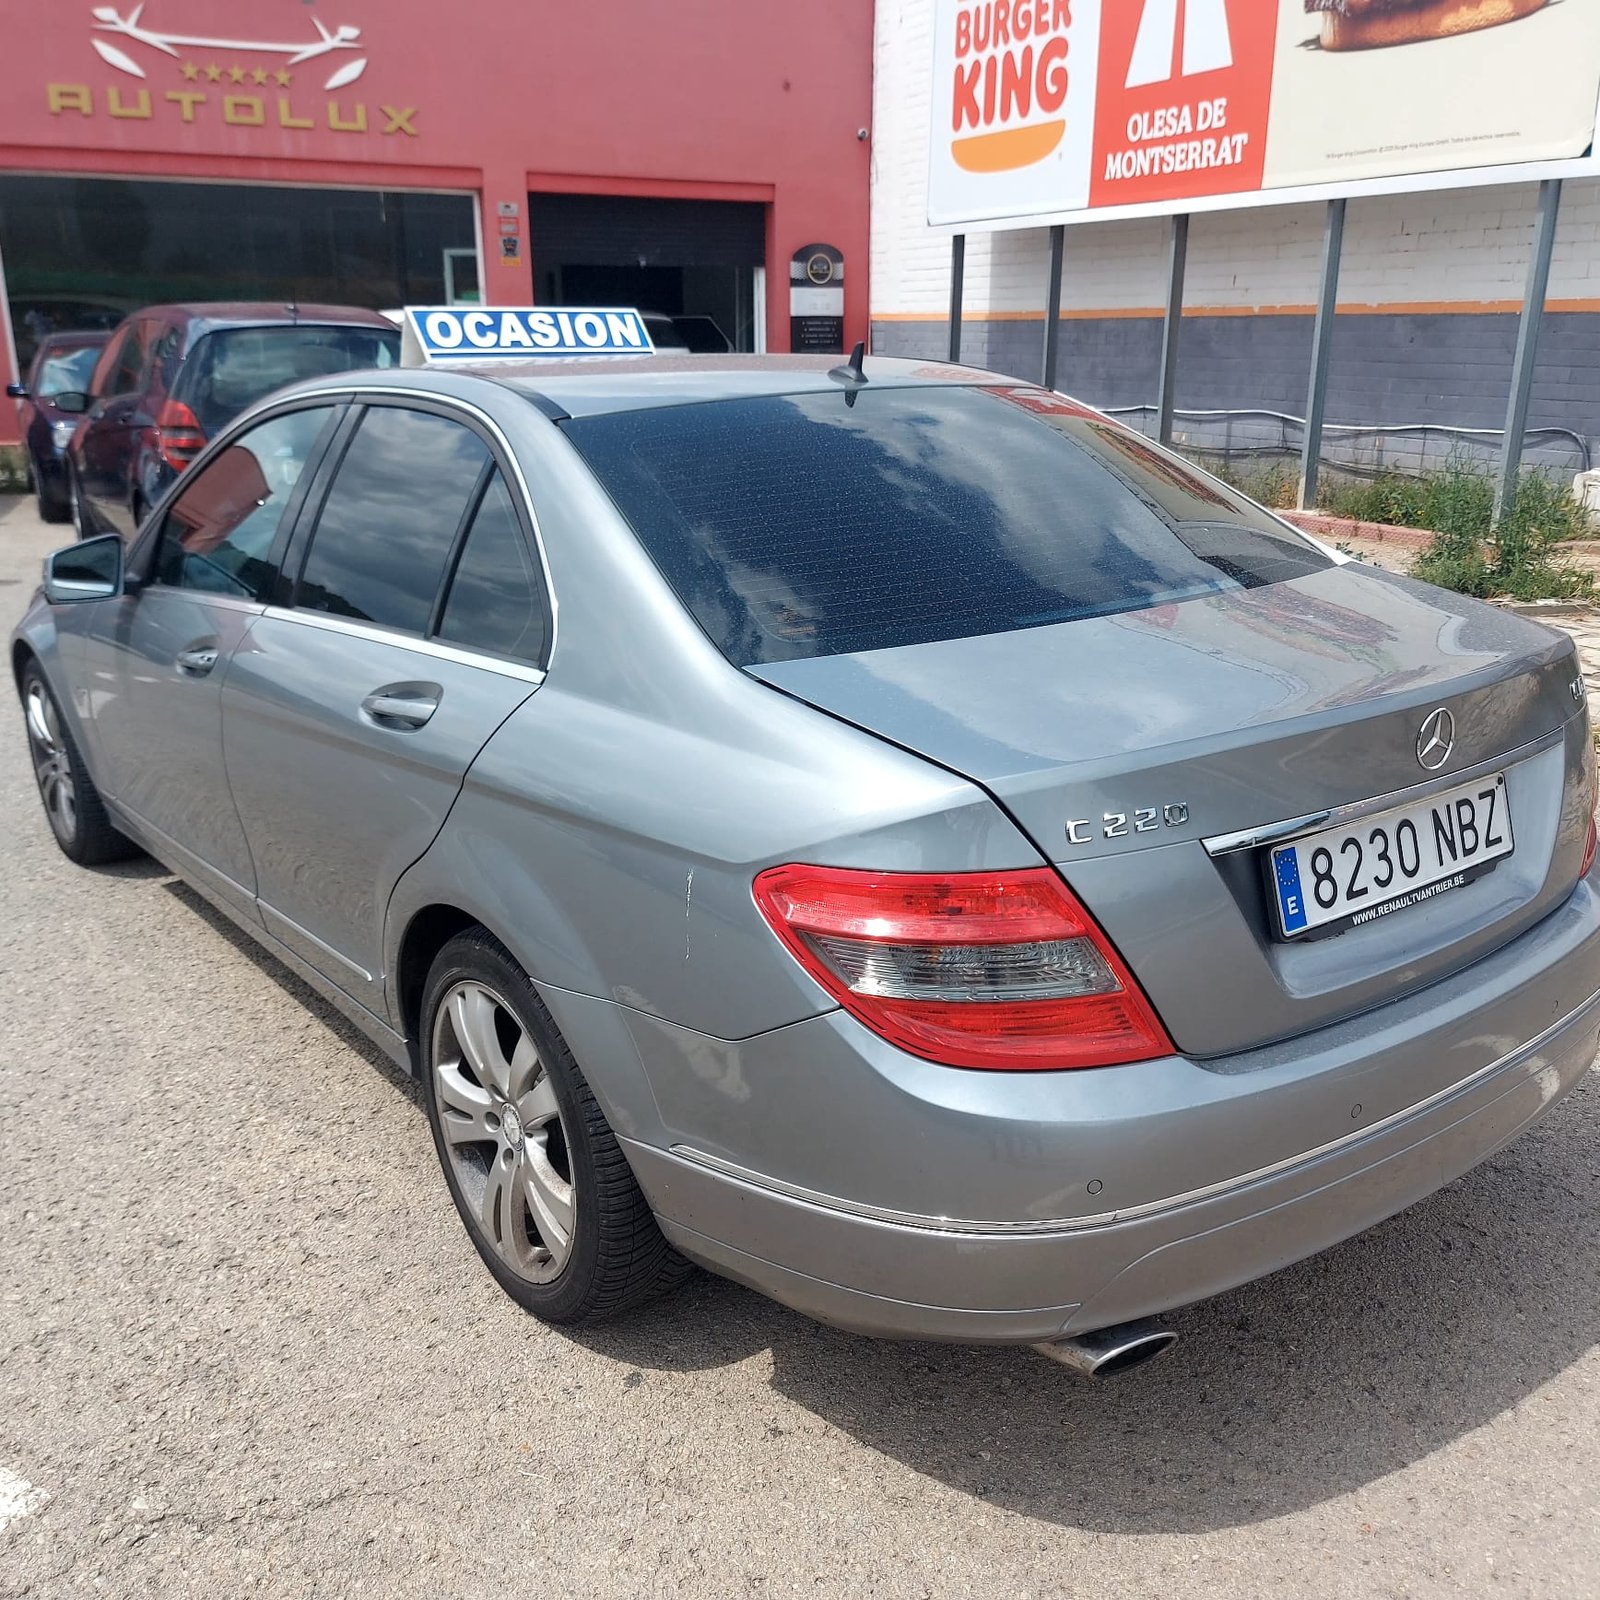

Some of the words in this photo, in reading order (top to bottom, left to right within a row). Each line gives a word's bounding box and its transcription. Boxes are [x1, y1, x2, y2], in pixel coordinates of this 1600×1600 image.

[955, 0, 1072, 58] BURGER
[952, 36, 1069, 132] KING
[47, 83, 419, 136] AUTOLUX
[1126, 105, 1193, 142] OLESA
[1195, 98, 1227, 132] DE
[1104, 134, 1249, 181] MONTSERRAT
[425, 312, 643, 348] OCASION
[1065, 818, 1094, 845] C
[1102, 801, 1189, 838] 220
[1310, 818, 1421, 909] 8230
[1431, 789, 1503, 867] NBZ
[1287, 896, 1299, 915] E
[1351, 874, 1465, 926] WWW.RENAULTVANTRIER.BE
